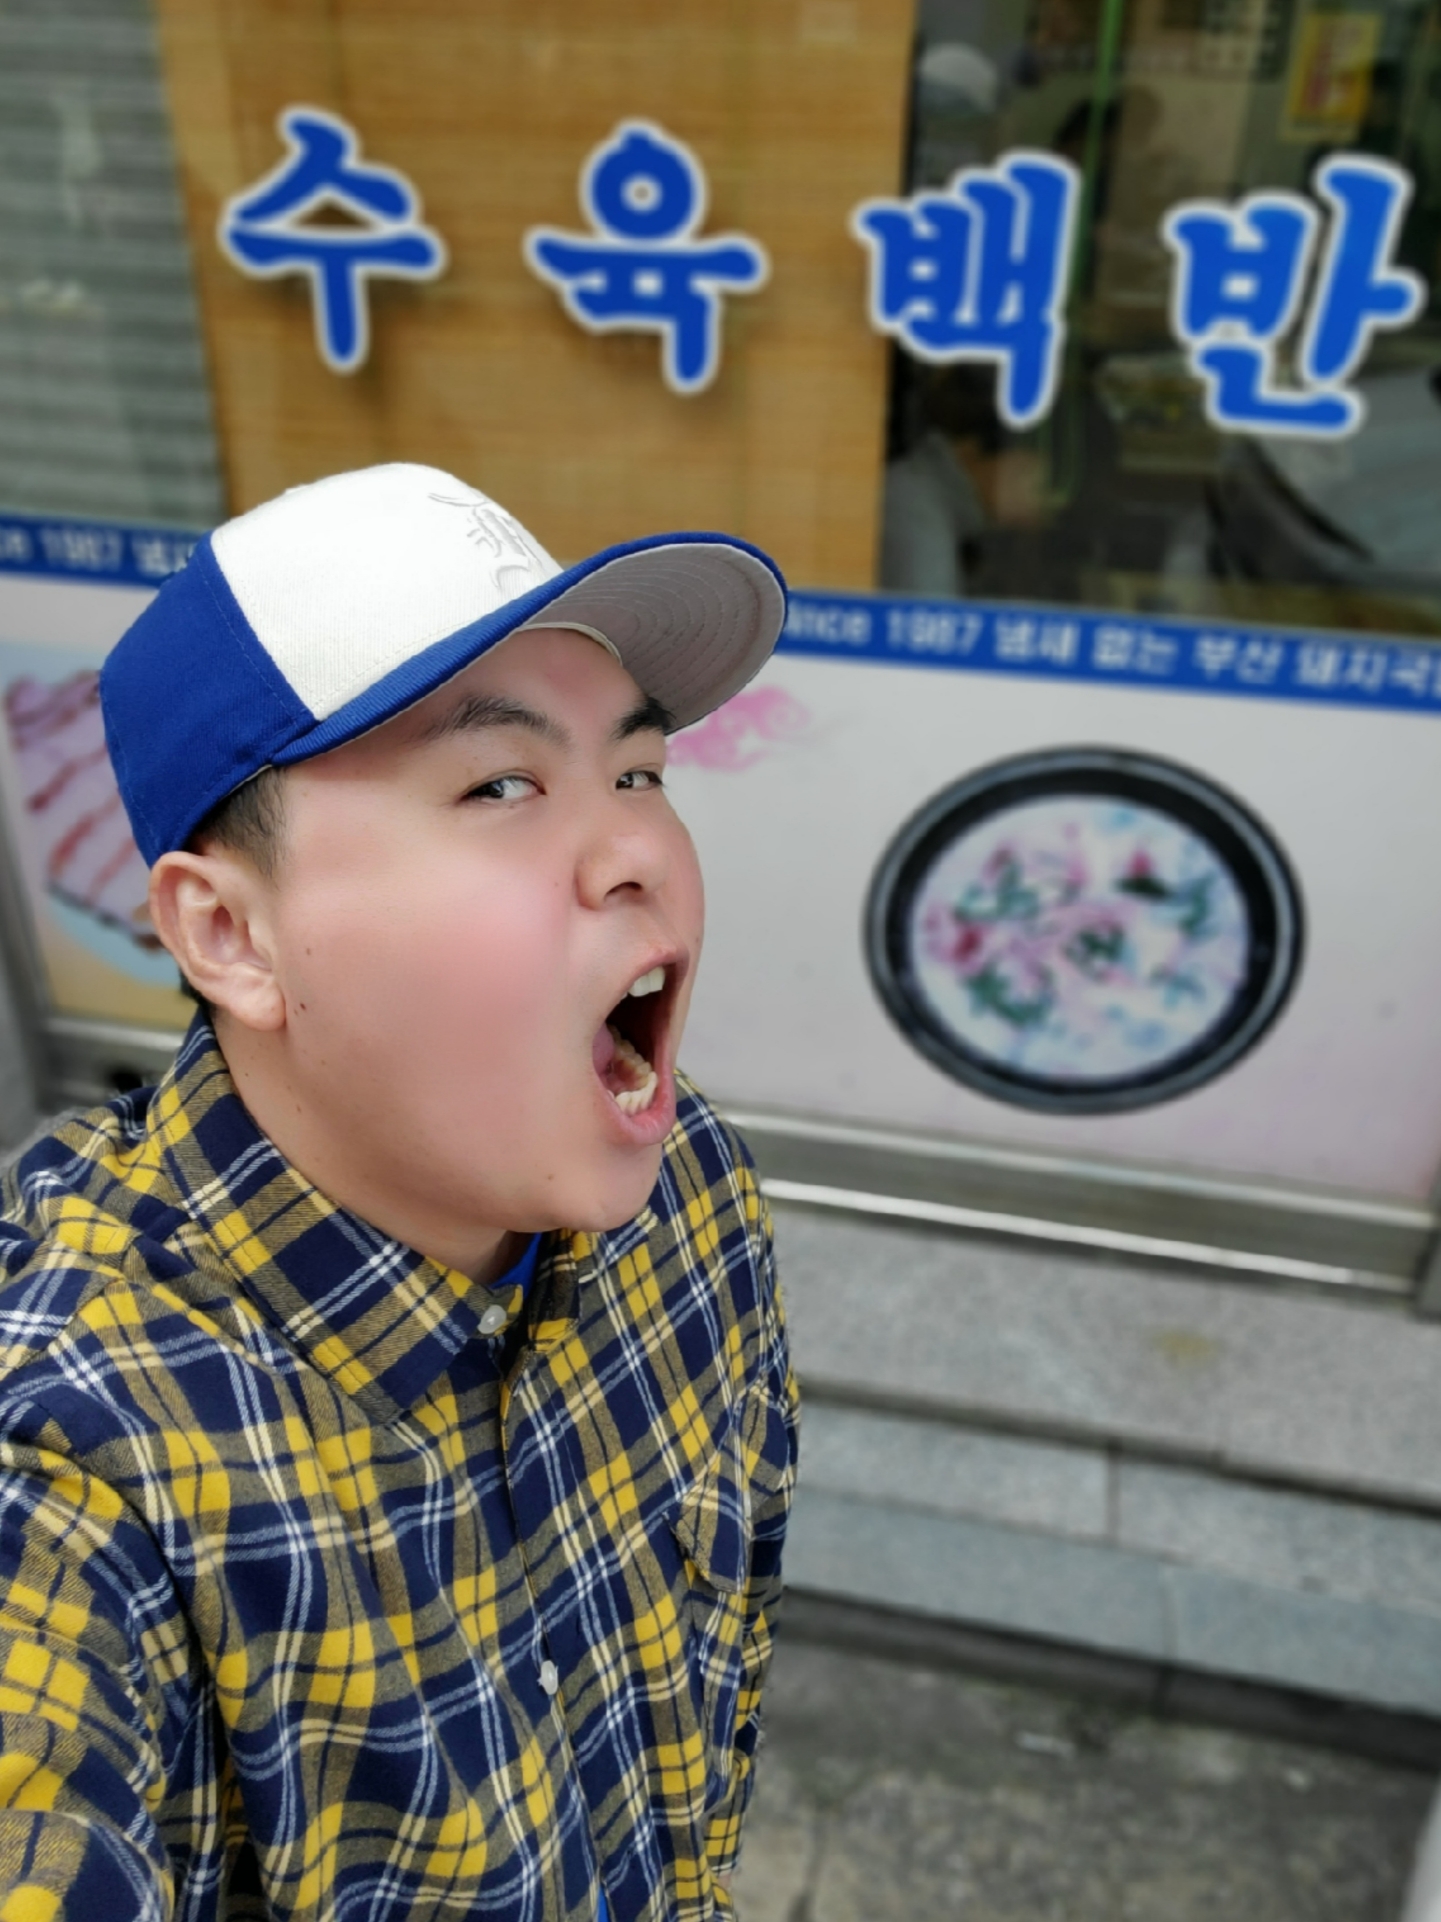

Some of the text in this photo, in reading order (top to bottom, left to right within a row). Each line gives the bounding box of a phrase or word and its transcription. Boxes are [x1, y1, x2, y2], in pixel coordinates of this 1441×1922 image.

[886, 605, 984, 657] 1987
[995, 612, 1082, 667] 냄새
[1092, 622, 1180, 677] 없는
[1195, 633, 1284, 687] 부산
[1292, 642, 1441, 700] 돼지국
